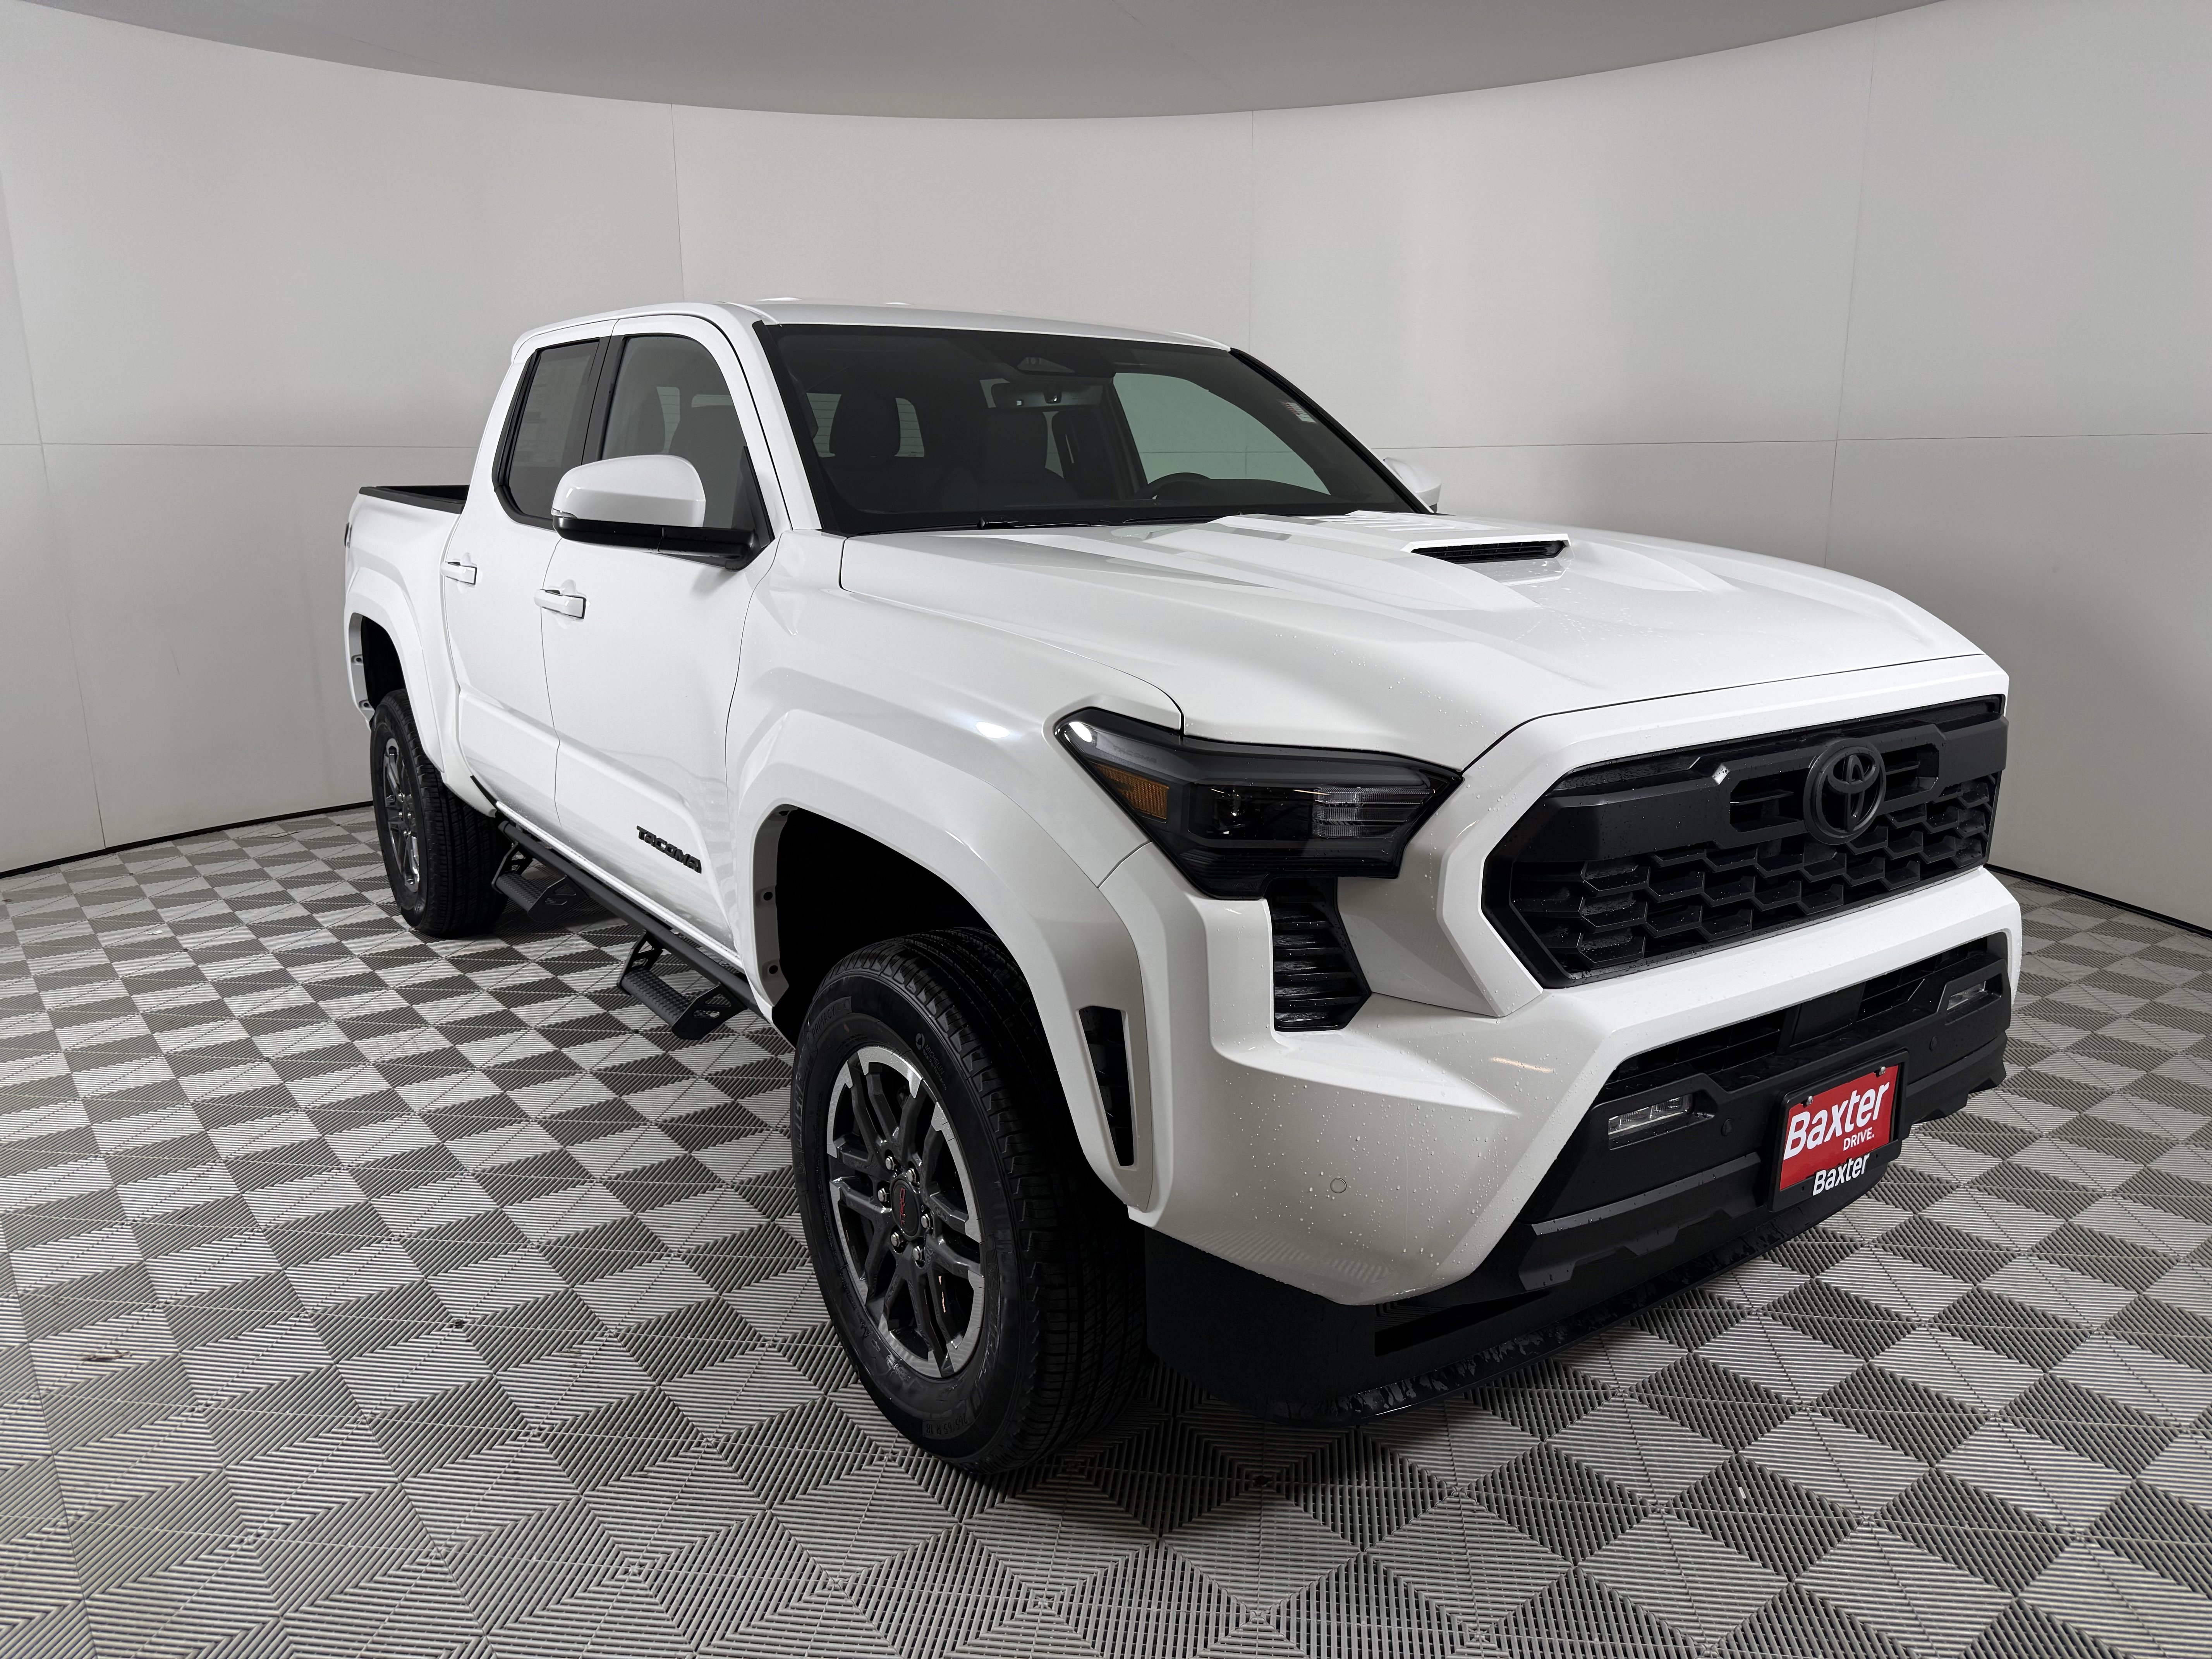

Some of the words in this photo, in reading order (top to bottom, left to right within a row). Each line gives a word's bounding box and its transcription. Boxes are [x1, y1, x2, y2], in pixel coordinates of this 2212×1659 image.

[637, 825, 702, 874] TACOMA
[812, 1006, 835, 1039] PRIMACY
[925, 1044, 945, 1075] MICHELIN
[1783, 1082, 1889, 1160] Baxter
[1843, 1127, 1874, 1151] DRIVE.
[1813, 1154, 1870, 1196] Baxter
